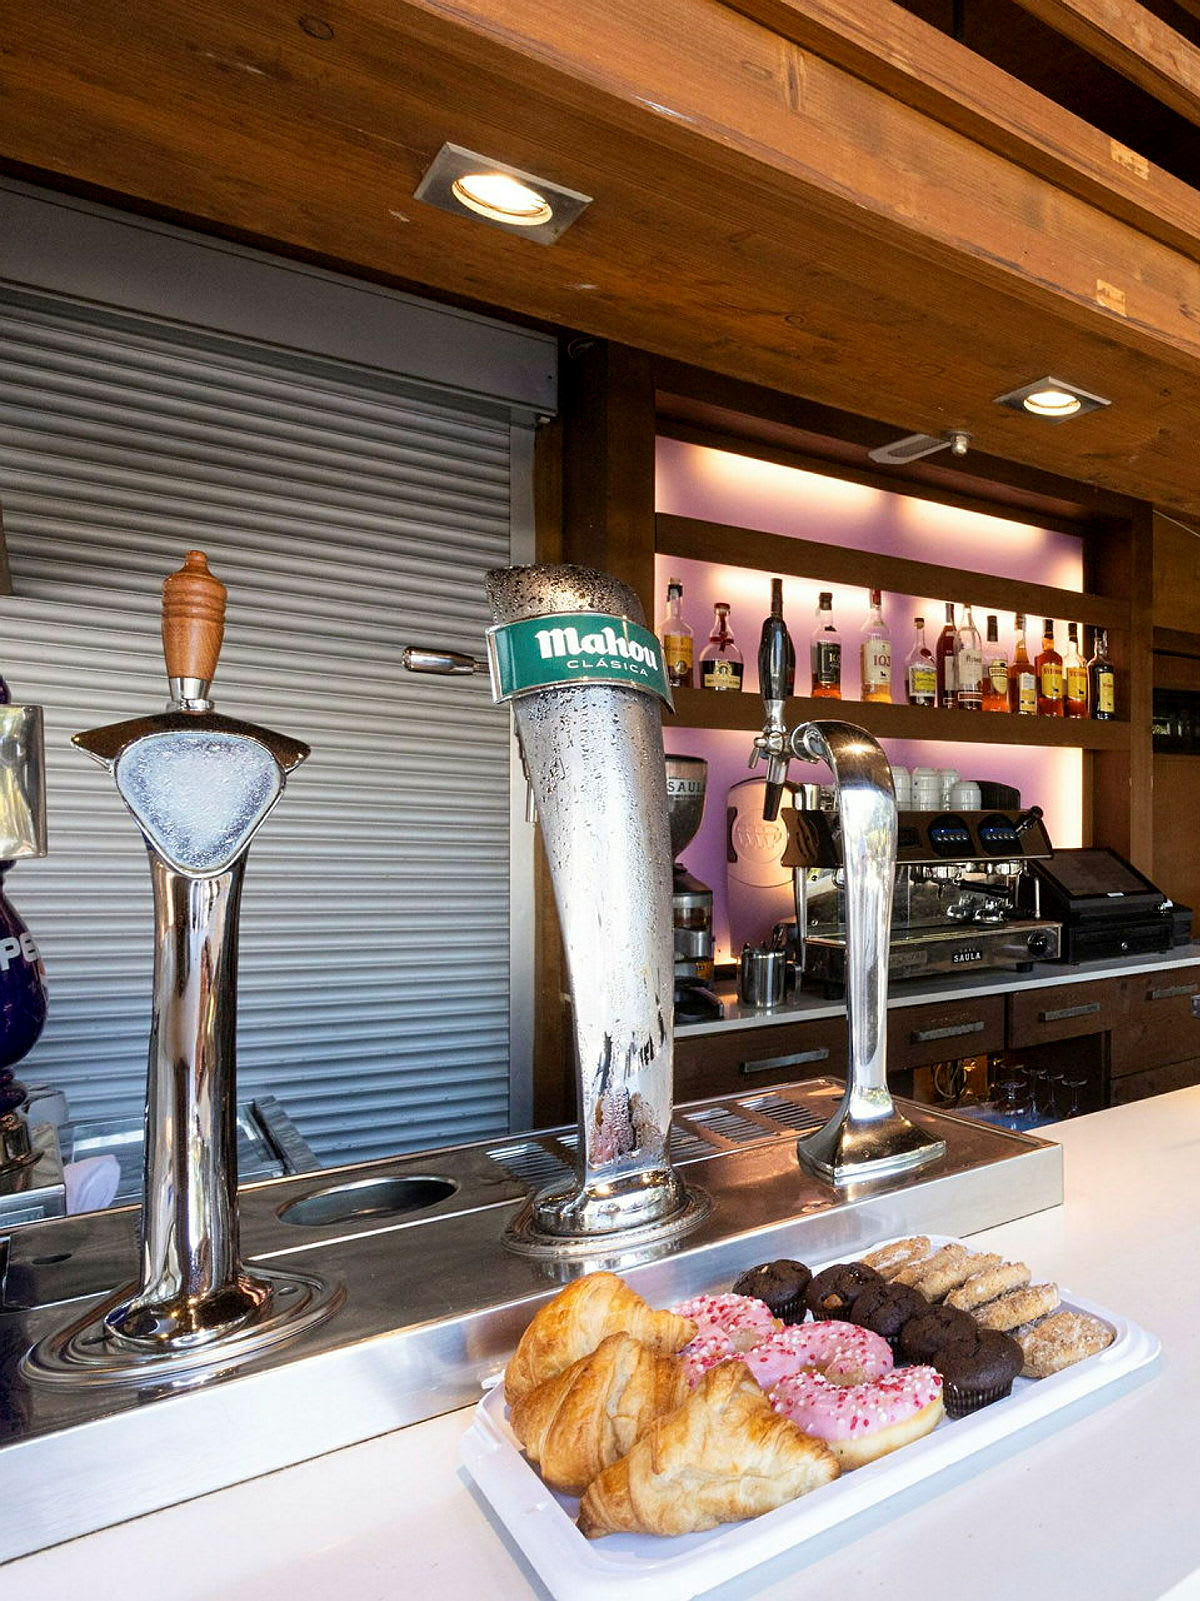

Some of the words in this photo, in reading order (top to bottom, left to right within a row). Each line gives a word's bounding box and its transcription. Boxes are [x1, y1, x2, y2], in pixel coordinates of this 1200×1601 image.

[534, 626, 659, 671] Mahou
[566, 657, 649, 677] CLÁSICA
[953, 952, 981, 963] SAULA
